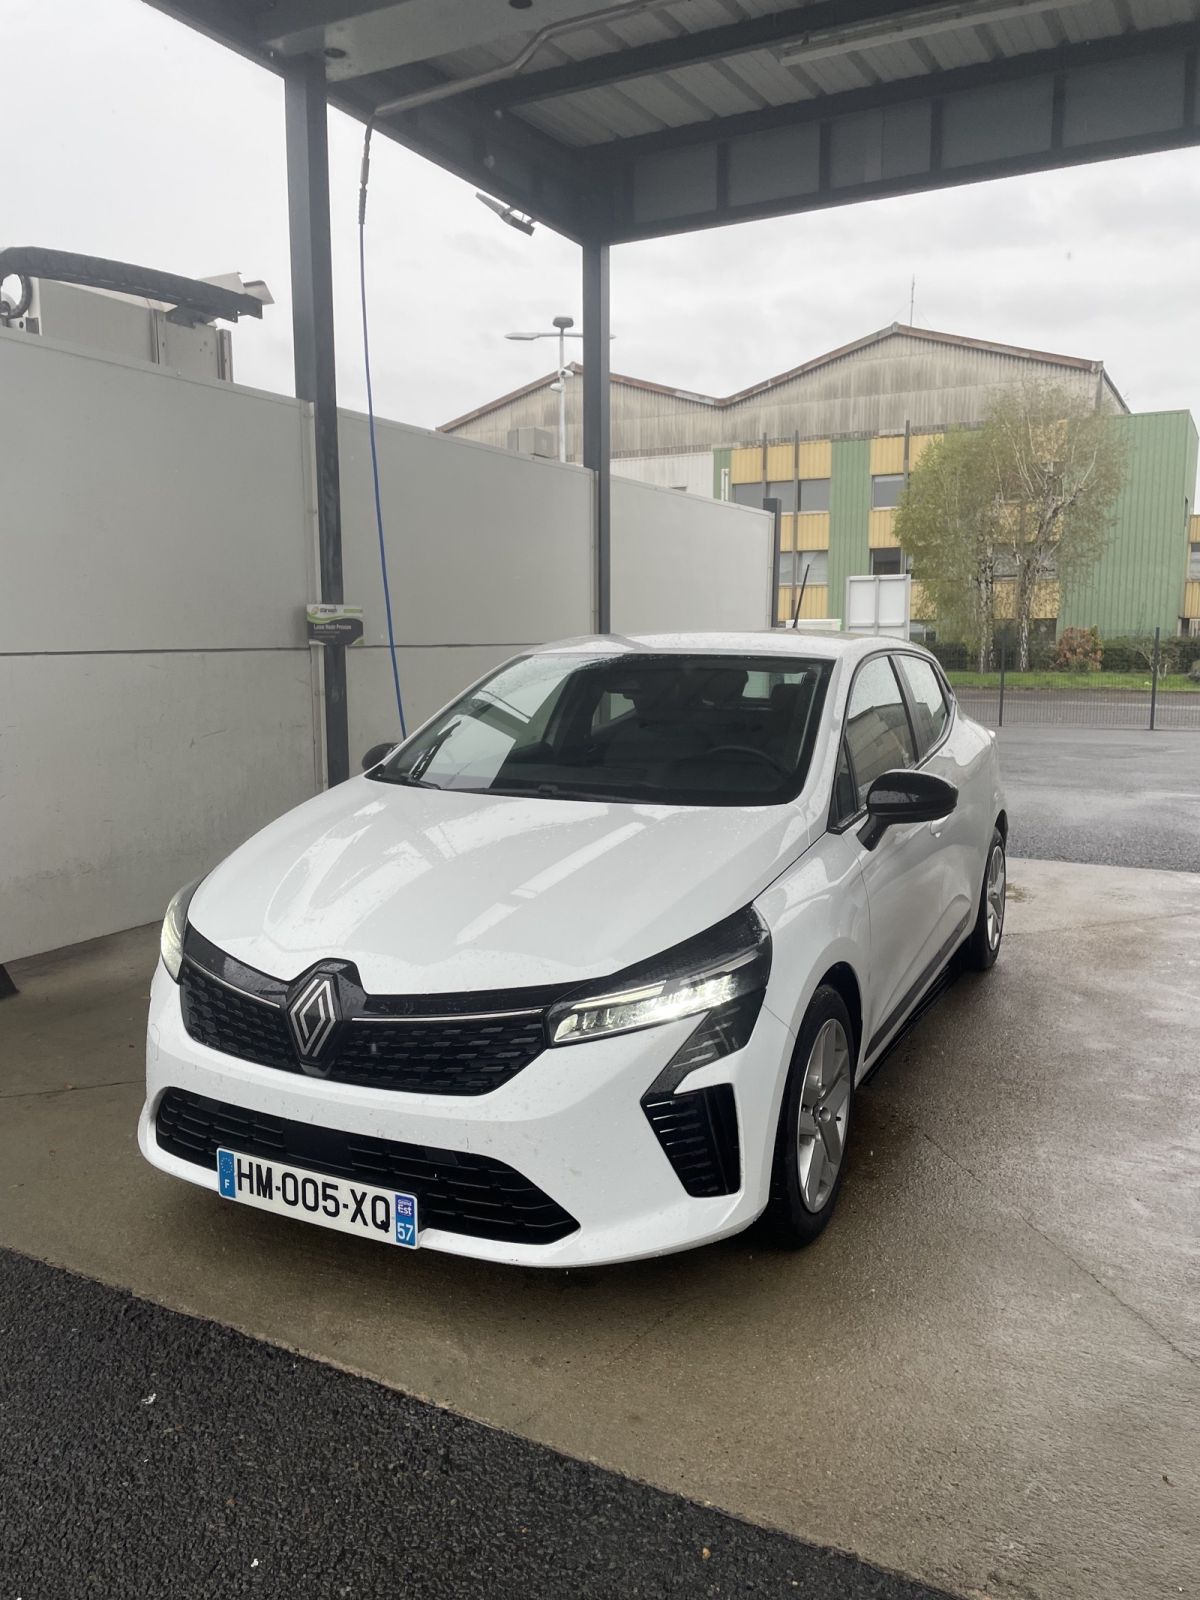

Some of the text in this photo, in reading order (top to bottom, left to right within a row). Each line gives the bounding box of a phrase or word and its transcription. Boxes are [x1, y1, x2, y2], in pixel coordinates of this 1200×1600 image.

[224, 1179, 230, 1189] F
[237, 1158, 391, 1233] HM-005-XQ
[397, 1204, 412, 1216] Est
[397, 1222, 413, 1241] 57
